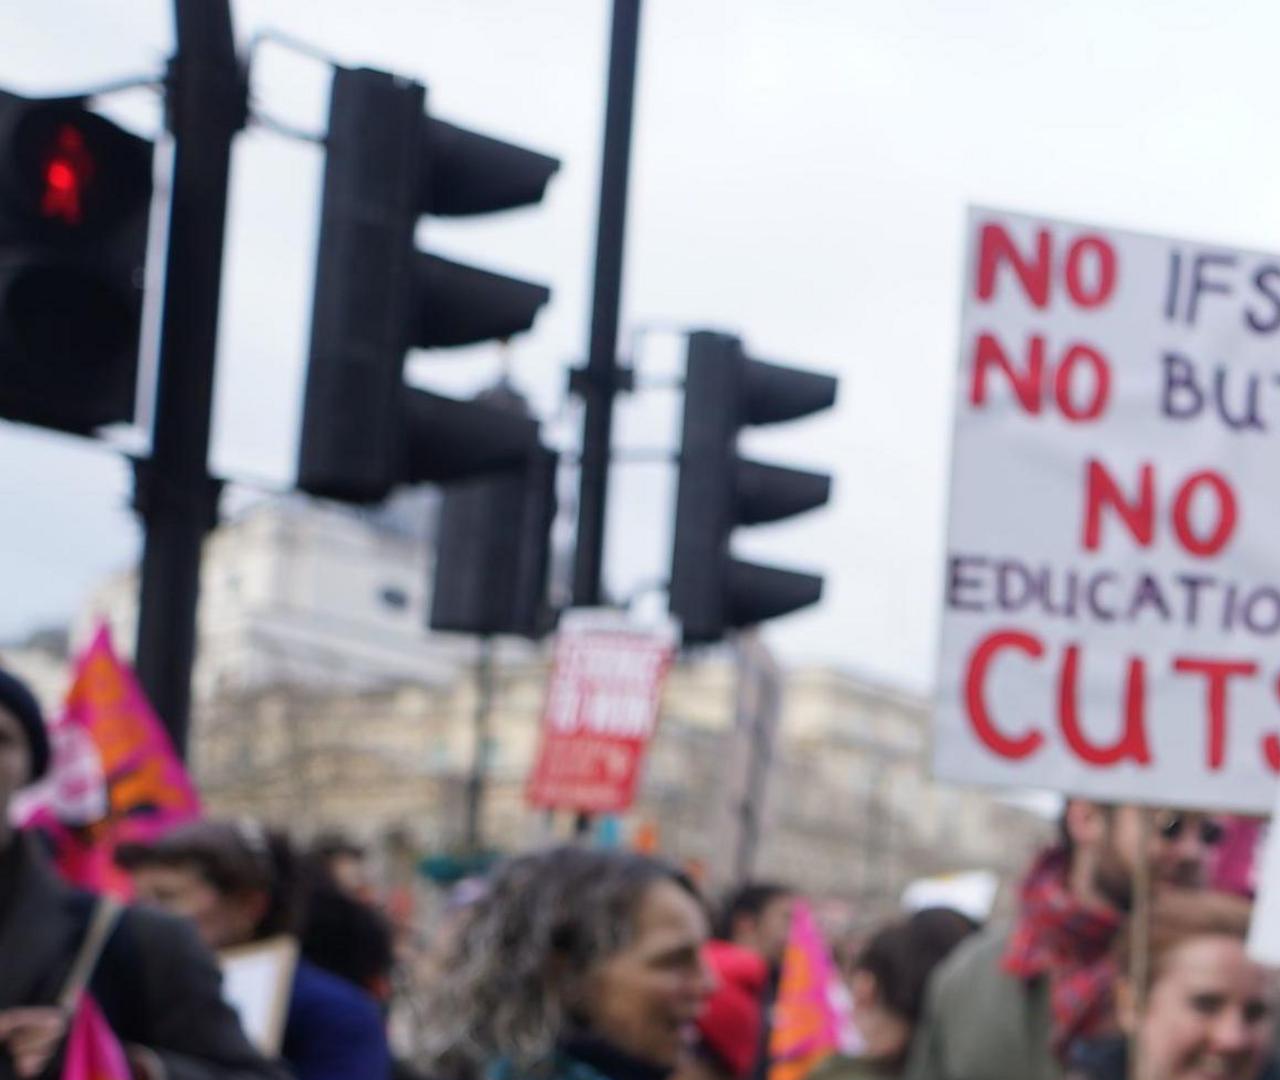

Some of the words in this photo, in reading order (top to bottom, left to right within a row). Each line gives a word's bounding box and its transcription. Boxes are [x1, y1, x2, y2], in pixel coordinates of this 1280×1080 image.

[976, 222, 1118, 311] NO
[970, 331, 1111, 423] NO
[1082, 454, 1239, 558] NO
